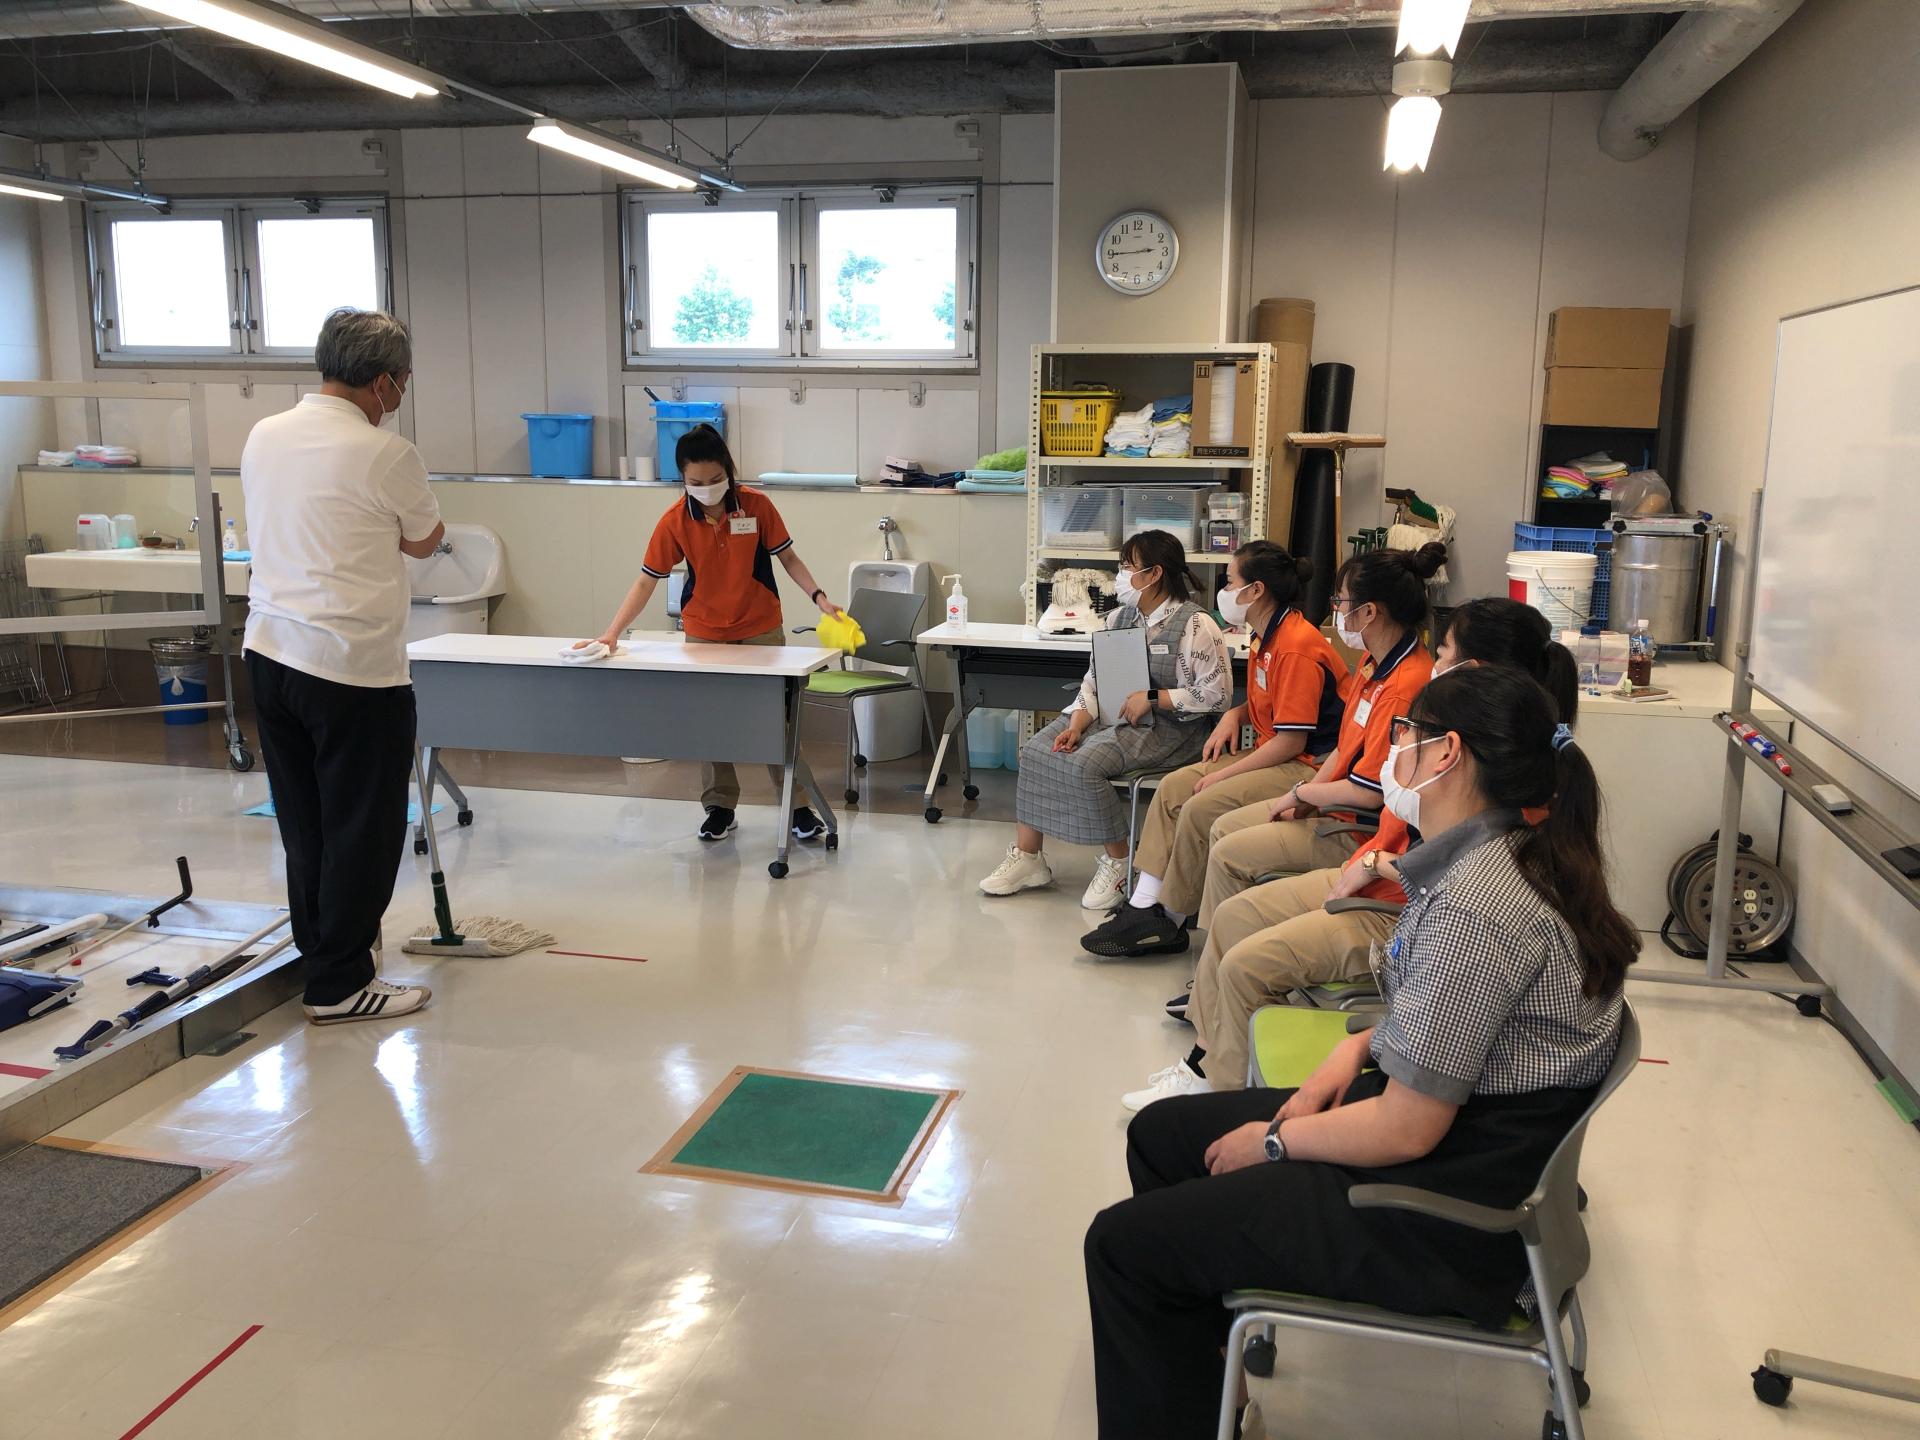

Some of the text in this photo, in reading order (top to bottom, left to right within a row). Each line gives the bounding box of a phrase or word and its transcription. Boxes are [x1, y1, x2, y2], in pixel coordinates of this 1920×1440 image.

[1121, 224, 1129, 234] 11
[1133, 220, 1143, 231] 12
[1111, 235, 1121, 245] 10
[1157, 233, 1164, 243] 2
[1107, 249, 1114, 259] 9
[1162, 247, 1168, 256] 3
[1112, 263, 1119, 273] 8
[1156, 260, 1162, 270] 4
[1121, 272, 1128, 282] 7
[1134, 274, 1140, 285] 6
[1148, 271, 1153, 281] 5
